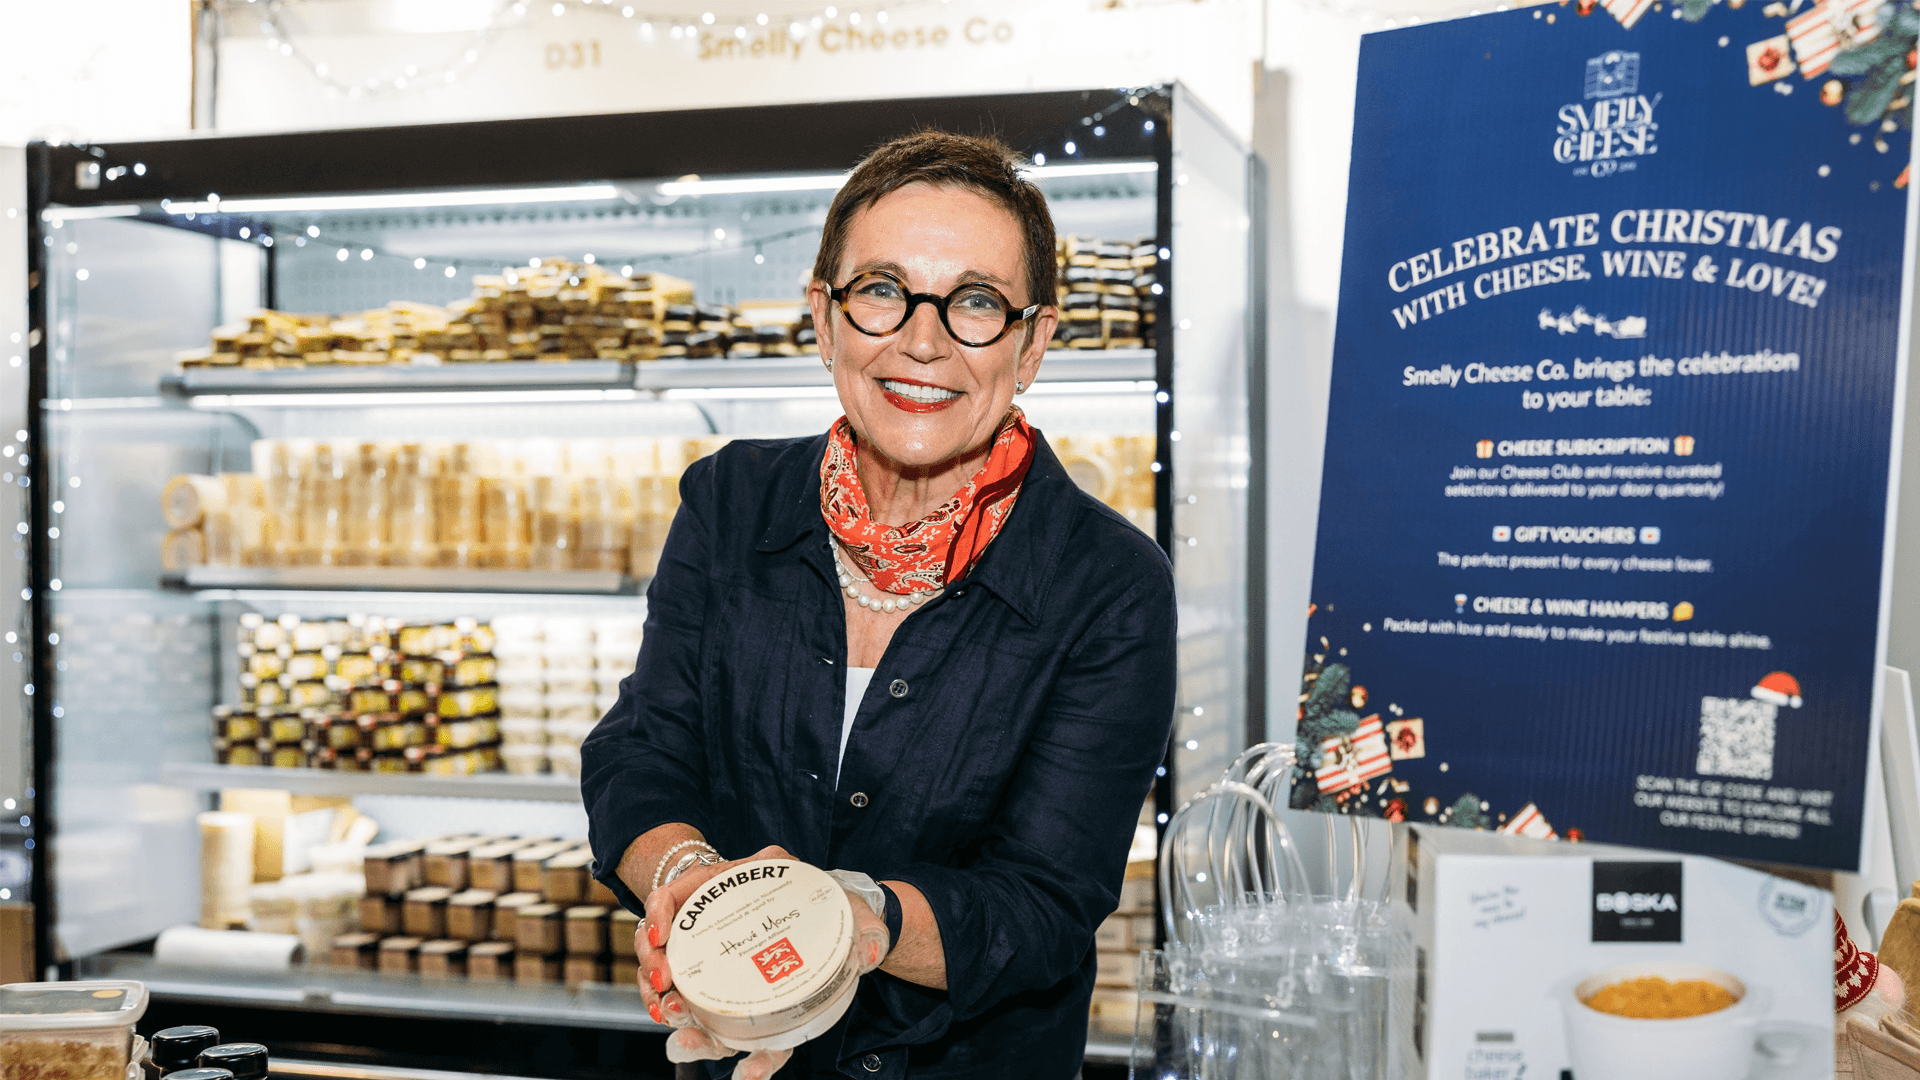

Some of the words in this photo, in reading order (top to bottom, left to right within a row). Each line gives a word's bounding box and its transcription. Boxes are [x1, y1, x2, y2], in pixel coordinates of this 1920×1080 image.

[544, 39, 602, 69] D31
[697, 28, 805, 60] Smelly
[819, 24, 950, 54] Cheese
[964, 17, 1014, 44] Co
[1557, 92, 1663, 135] SMELLY
[1553, 124, 1658, 163] CHEESE
[1388, 212, 1600, 293] CELEBRATE
[1610, 209, 1842, 262] CHRISTMAS
[1391, 280, 1468, 330] WITH
[1473, 253, 1592, 300] CHEESE,
[1601, 250, 1687, 279] WINE
[1692, 255, 1719, 283] &
[1725, 258, 1827, 308] LOVE!
[1402, 363, 1462, 388] Smelly
[1464, 362, 1534, 384] Cheese
[1536, 358, 1569, 381] Co.
[1573, 356, 1635, 382] brings
[1639, 353, 1675, 377] the
[1677, 348, 1800, 376] celebration
[1522, 389, 1544, 409] to
[1546, 390, 1593, 412] your
[1595, 383, 1652, 407] table:
[1497, 439, 1554, 457] CHEESE
[1556, 437, 1669, 456] SUBSCRIPTION
[1449, 465, 1476, 480] Join
[1477, 467, 1500, 480] our
[1500, 464, 1550, 480] Cheese
[1551, 463, 1583, 479] Club
[1584, 463, 1612, 479] and
[1612, 463, 1664, 479] receive
[1664, 462, 1723, 479] curated
[1445, 482, 1508, 497] selections
[1509, 482, 1570, 497] delivered
[1570, 483, 1586, 497] to
[1587, 484, 1618, 500] your
[1619, 481, 1654, 497] door
[1654, 481, 1725, 500] quarterly!
[1514, 526, 1549, 543] GIFT
[1549, 526, 1636, 544] VOUCHERS
[1437, 551, 1461, 567] The
[1461, 552, 1508, 570] perfect
[1508, 555, 1560, 571] present
[1561, 553, 1581, 569] for
[1582, 556, 1621, 573] every
[1622, 554, 1674, 572] cheese
[1674, 555, 1714, 573] lover.
[1473, 596, 1530, 615] CHEESE
[1530, 598, 1544, 615] &
[1545, 598, 1589, 617] WINE
[1589, 599, 1669, 620] HAMPERS
[1383, 617, 1429, 634] Packed
[1429, 619, 1456, 634] with
[1456, 620, 1484, 637] love
[1484, 622, 1511, 638] and
[1511, 623, 1549, 642] ready
[1550, 625, 1567, 641] to
[1567, 625, 1605, 642] make
[1606, 629, 1638, 645] your
[1639, 627, 1688, 646] festive
[1688, 629, 1727, 648] table
[1636, 774, 1674, 792] SCAN
[1675, 778, 1700, 795] THE
[1701, 780, 1722, 797] QR
[1723, 782, 1765, 801] CODE
[1765, 786, 1798, 805] AND
[1798, 789, 1834, 808] VISIT
[1634, 791, 1664, 809] OUR
[1664, 794, 1720, 815] WEBSITE
[1723, 798, 1743, 817] TO
[1742, 800, 1804, 823] EXPLORE
[1804, 807, 1833, 826] ALL
[1659, 810, 1690, 828] OUR
[1690, 812, 1743, 834] FESTIVE
[679, 865, 789, 931] CAMEMBERT
[1596, 891, 1678, 914] BOSKA
[720, 930, 758, 956] Hervé
[761, 909, 800, 932] Mons
